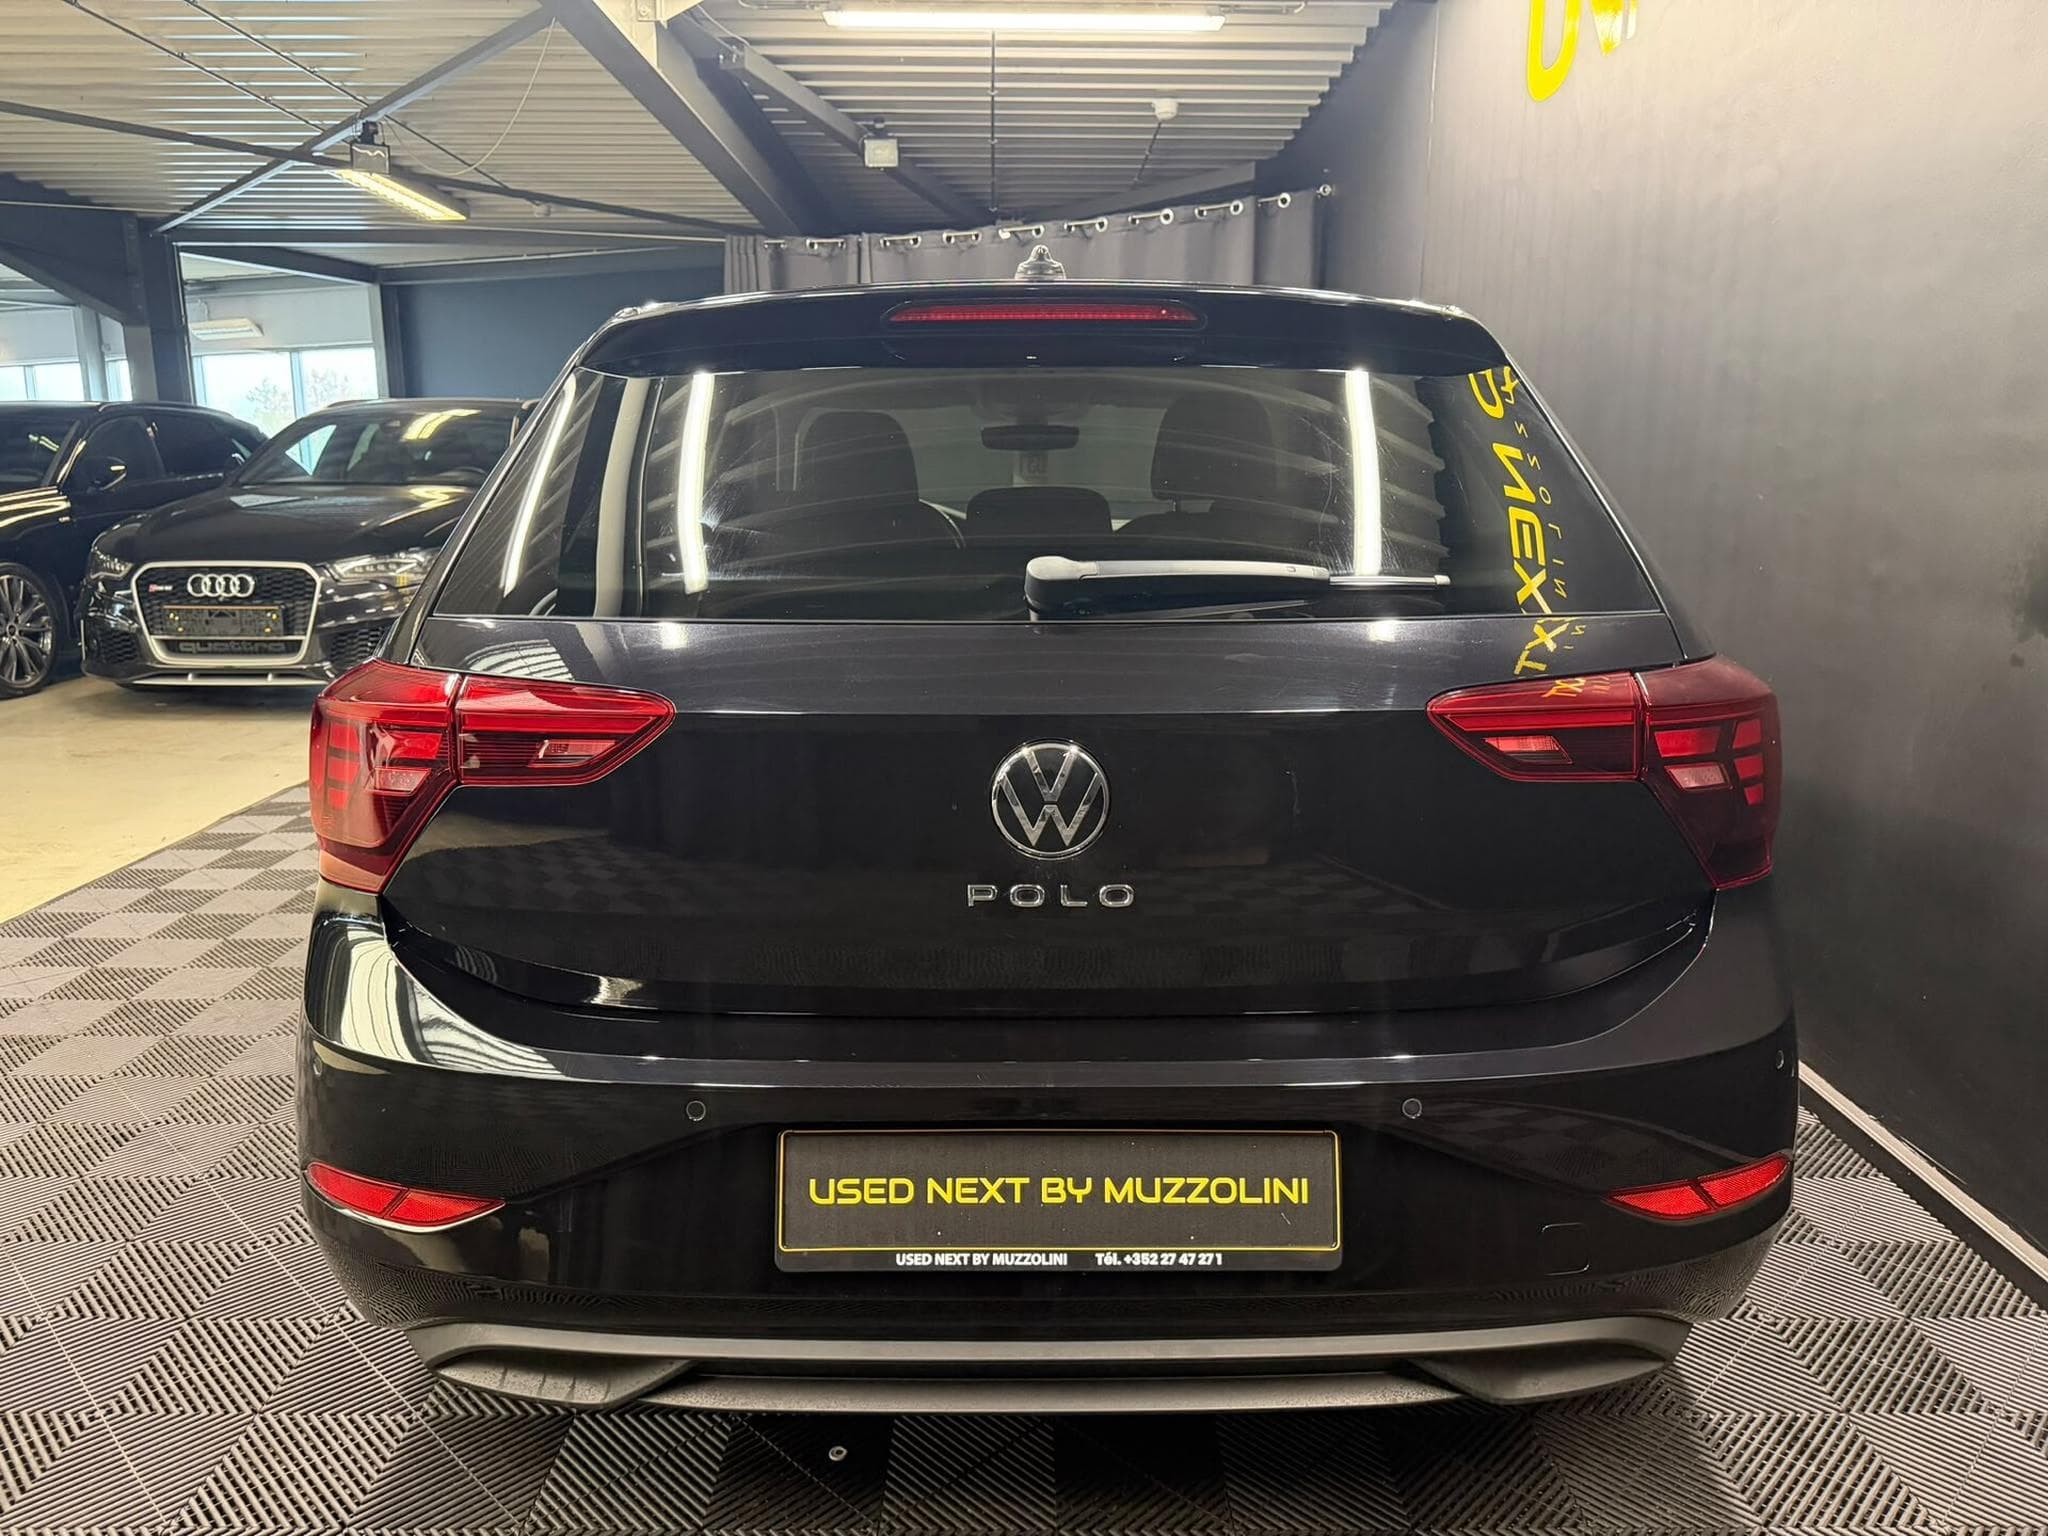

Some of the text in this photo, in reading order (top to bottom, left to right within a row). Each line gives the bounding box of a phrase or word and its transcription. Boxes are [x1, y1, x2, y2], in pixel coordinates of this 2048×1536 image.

[179, 641, 286, 653] quattro
[967, 884, 1135, 907] POLO
[809, 1177, 1309, 1208] USED NEXT BY MUZZOLINI
[895, 1253, 932, 1267] USED
[934, 1253, 970, 1267] NEXT
[971, 1253, 990, 1267] BY
[991, 1253, 1068, 1267] MUZZOLINI
[1095, 1251, 1122, 1267] Tél.
[1123, 1252, 1159, 1267] +352
